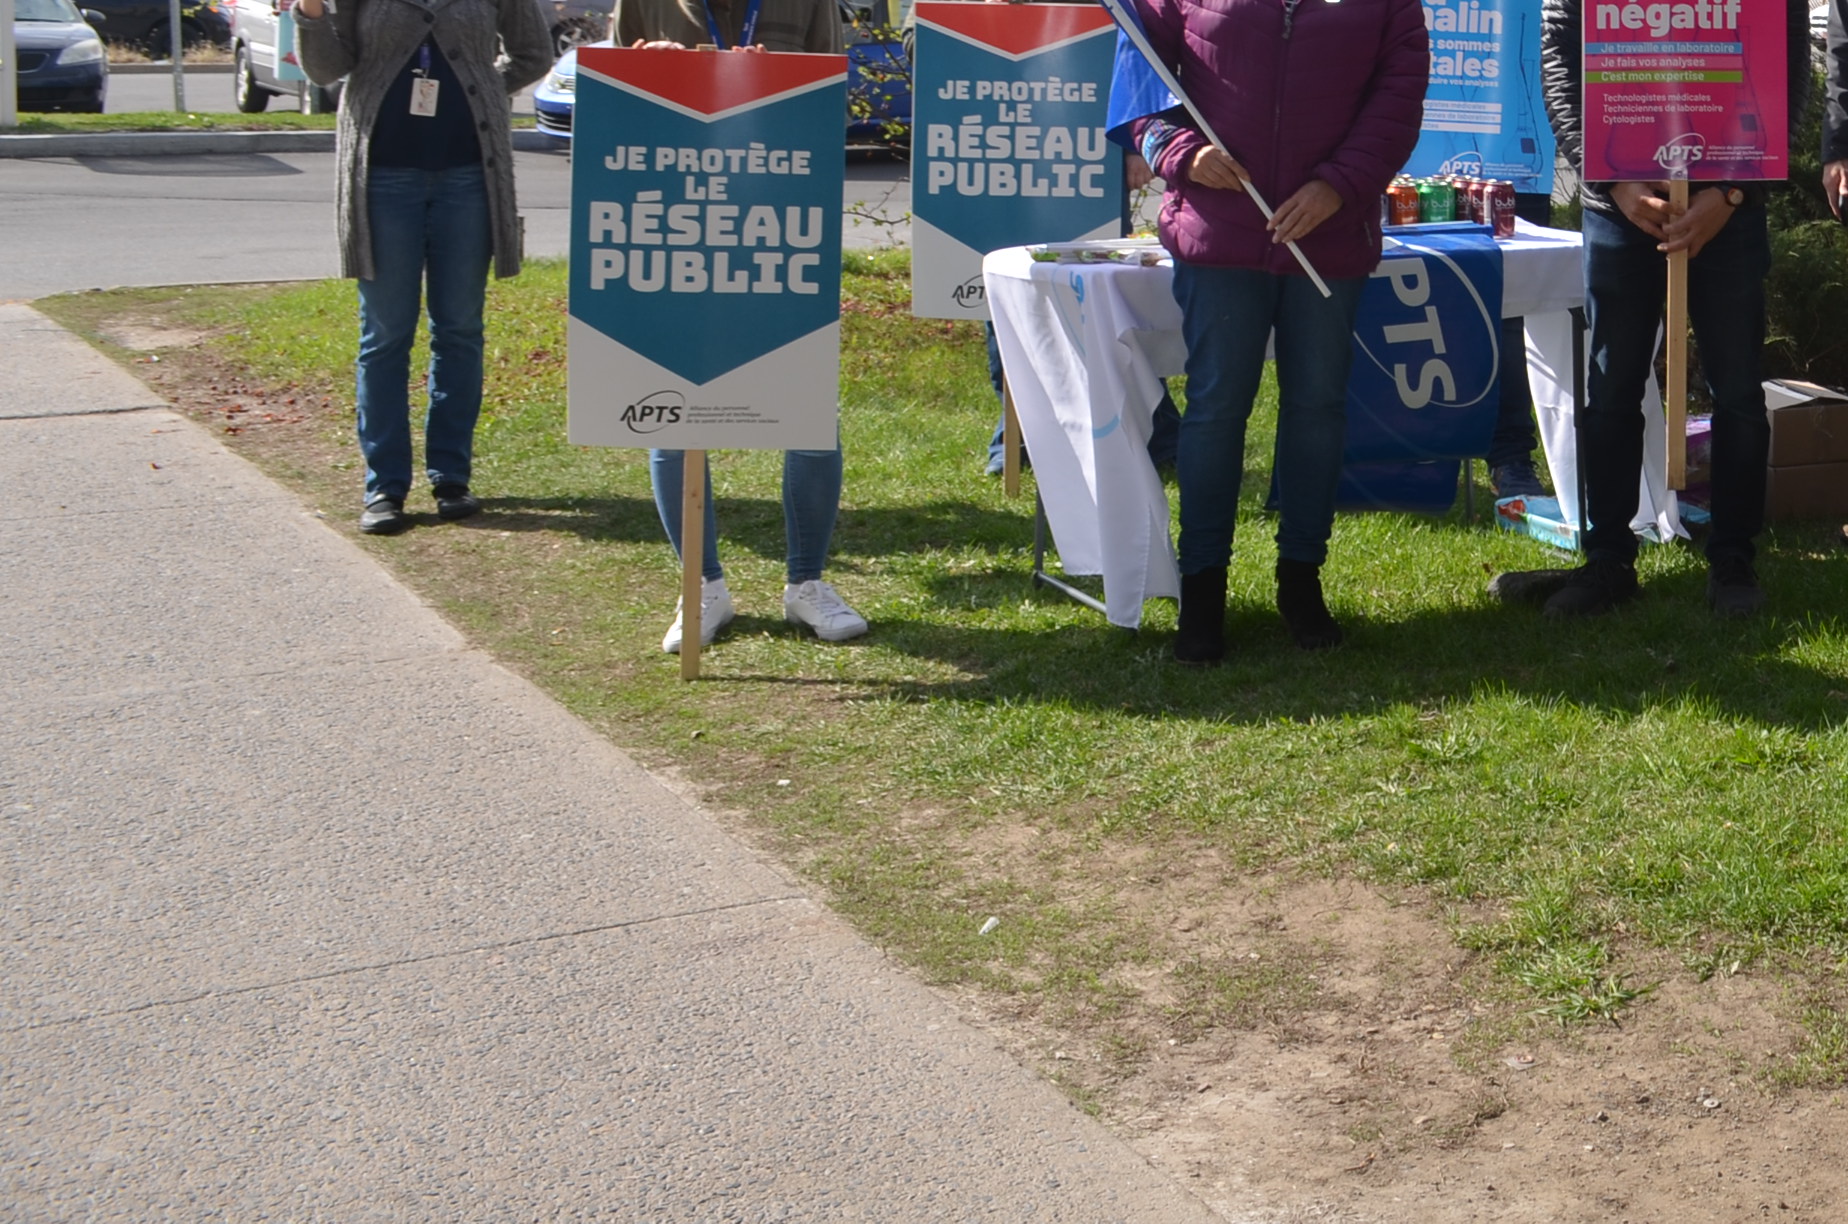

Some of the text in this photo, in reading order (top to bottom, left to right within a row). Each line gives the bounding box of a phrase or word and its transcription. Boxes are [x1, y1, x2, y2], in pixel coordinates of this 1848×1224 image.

[1437, 39, 1500, 52] sommes
[1601, 43, 1735, 53] Je travaille en laboratoire
[1429, 51, 1499, 78] tales
[1601, 57, 1705, 68] Je fais vos analyses
[1601, 71, 1705, 83] C'est mon expertise
[938, 76, 1097, 102] JE PROTÈGE
[1603, 93, 1711, 103] Technologistes médicales
[998, 103, 1032, 123] LE
[1603, 104, 1723, 113] Techniciennes de laboratoire
[1603, 115, 1655, 125] Cytologistes
[927, 114, 1107, 161] RÉSEAU
[604, 142, 811, 175] JE PROTÈGE
[1653, 145, 1703, 161] APTS
[1439, 160, 1481, 175] APTS
[685, 176, 728, 200] LE
[928, 161, 1105, 197] PUBLIC
[589, 190, 823, 248] RÉSEAU
[590, 248, 820, 294] PUBLIC
[952, 284, 985, 299] APT
[620, 404, 682, 424] APTS
